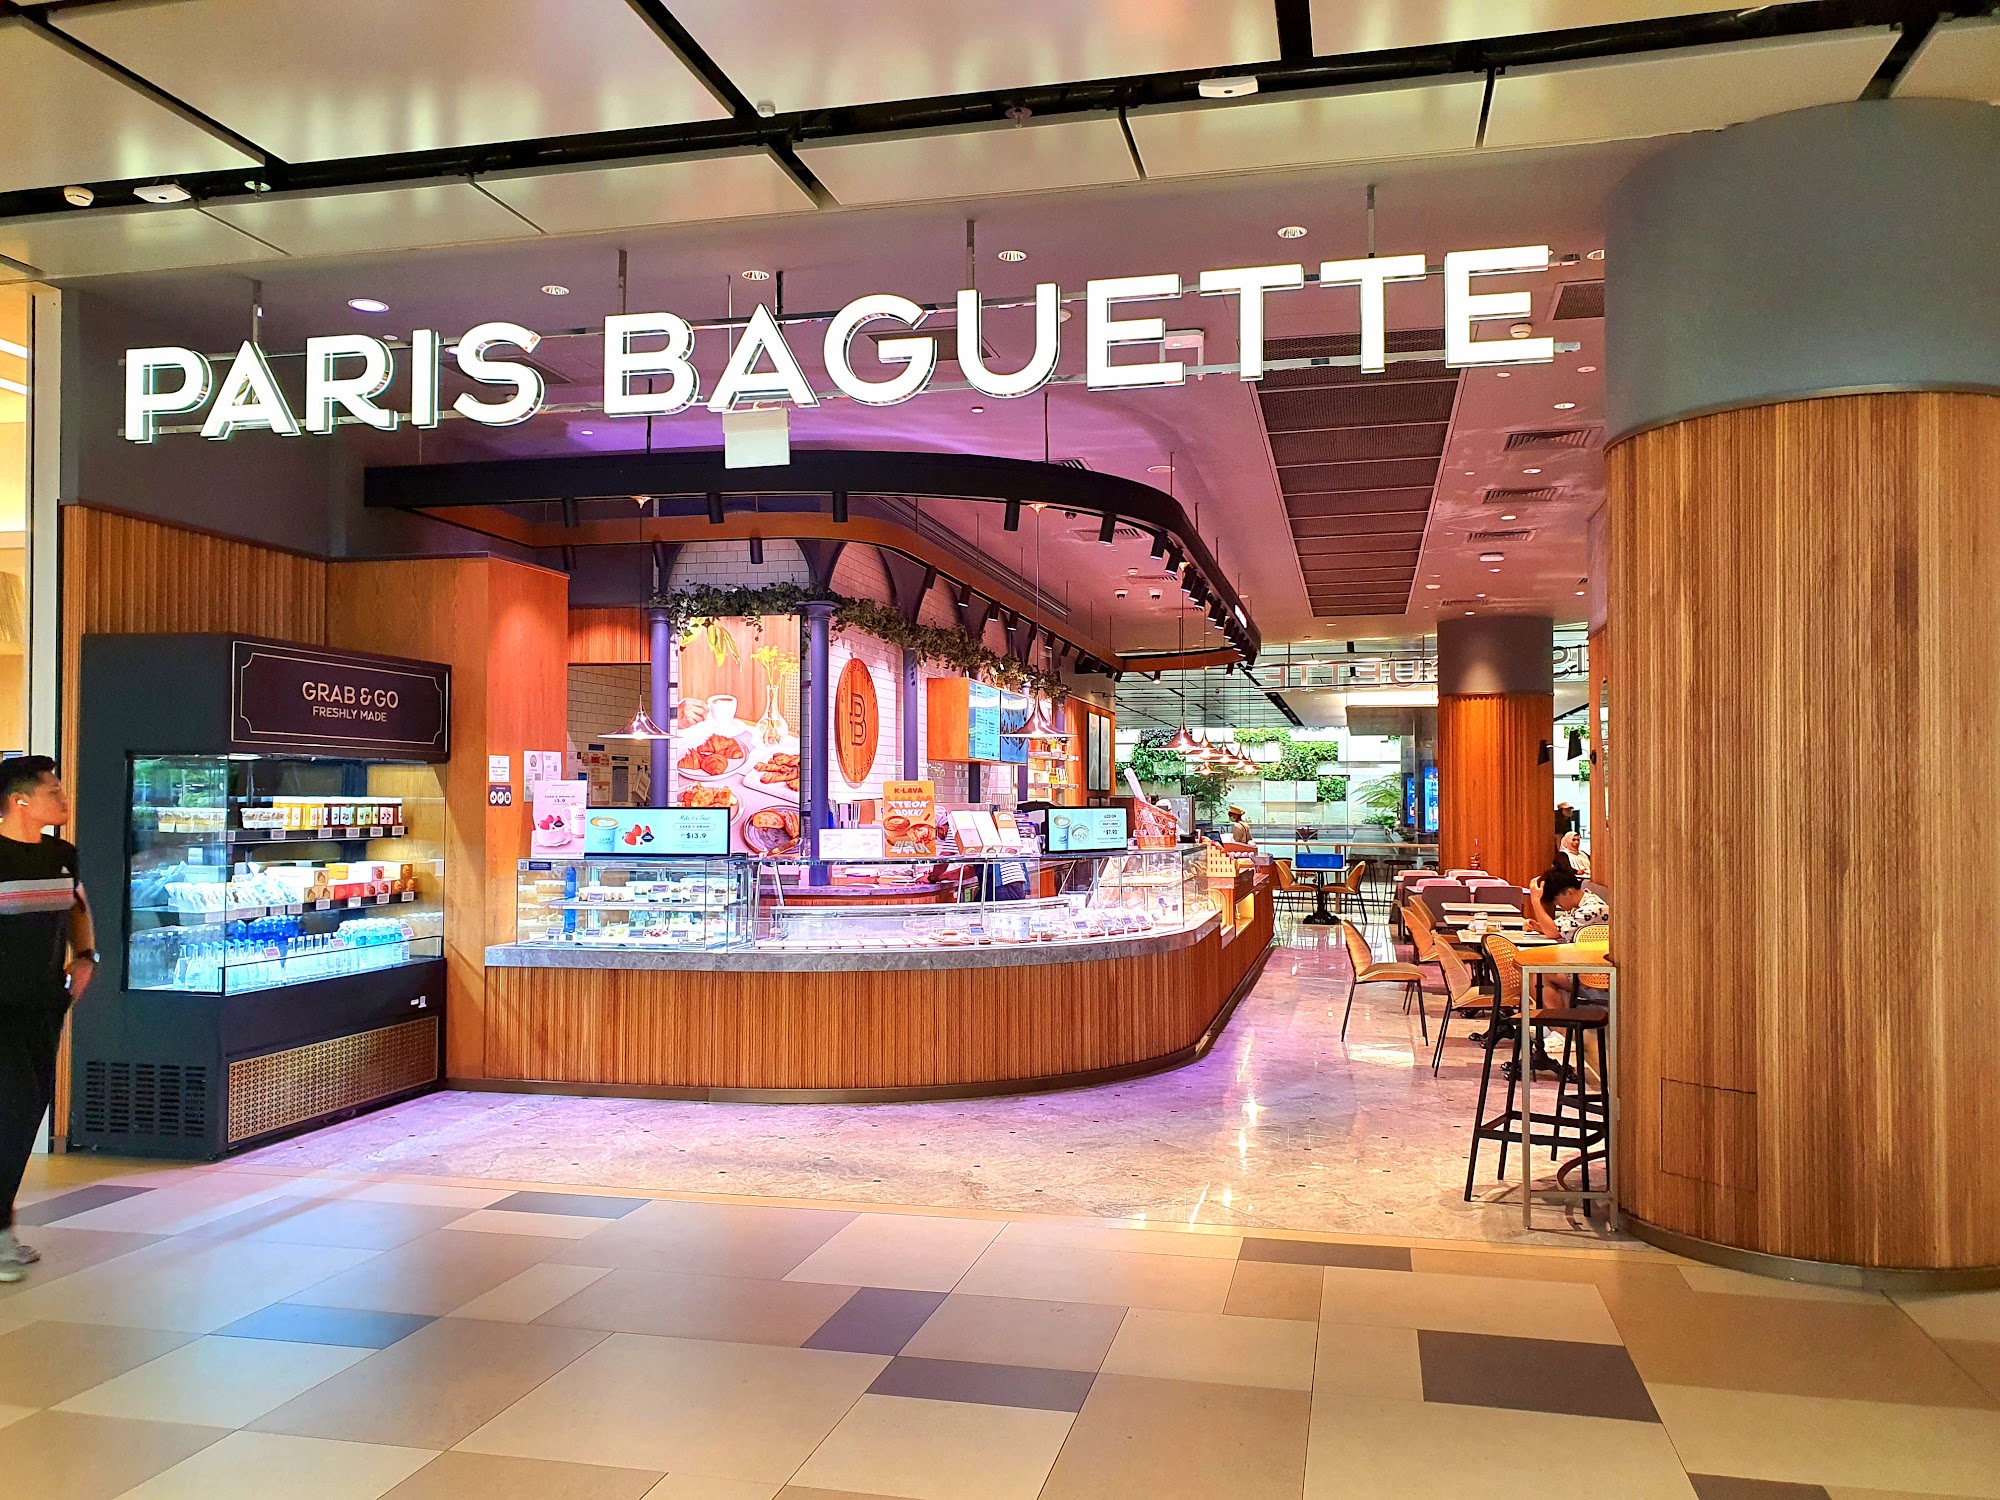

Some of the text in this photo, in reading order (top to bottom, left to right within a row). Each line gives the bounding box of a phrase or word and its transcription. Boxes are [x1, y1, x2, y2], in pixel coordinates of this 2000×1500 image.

[125, 244, 1556, 443] PARIS BAGUETTE
[302, 681, 399, 709] GRAB & GO
[312, 705, 388, 722] FRESHLY MADE
[893, 808, 925, 817] BOKKI
